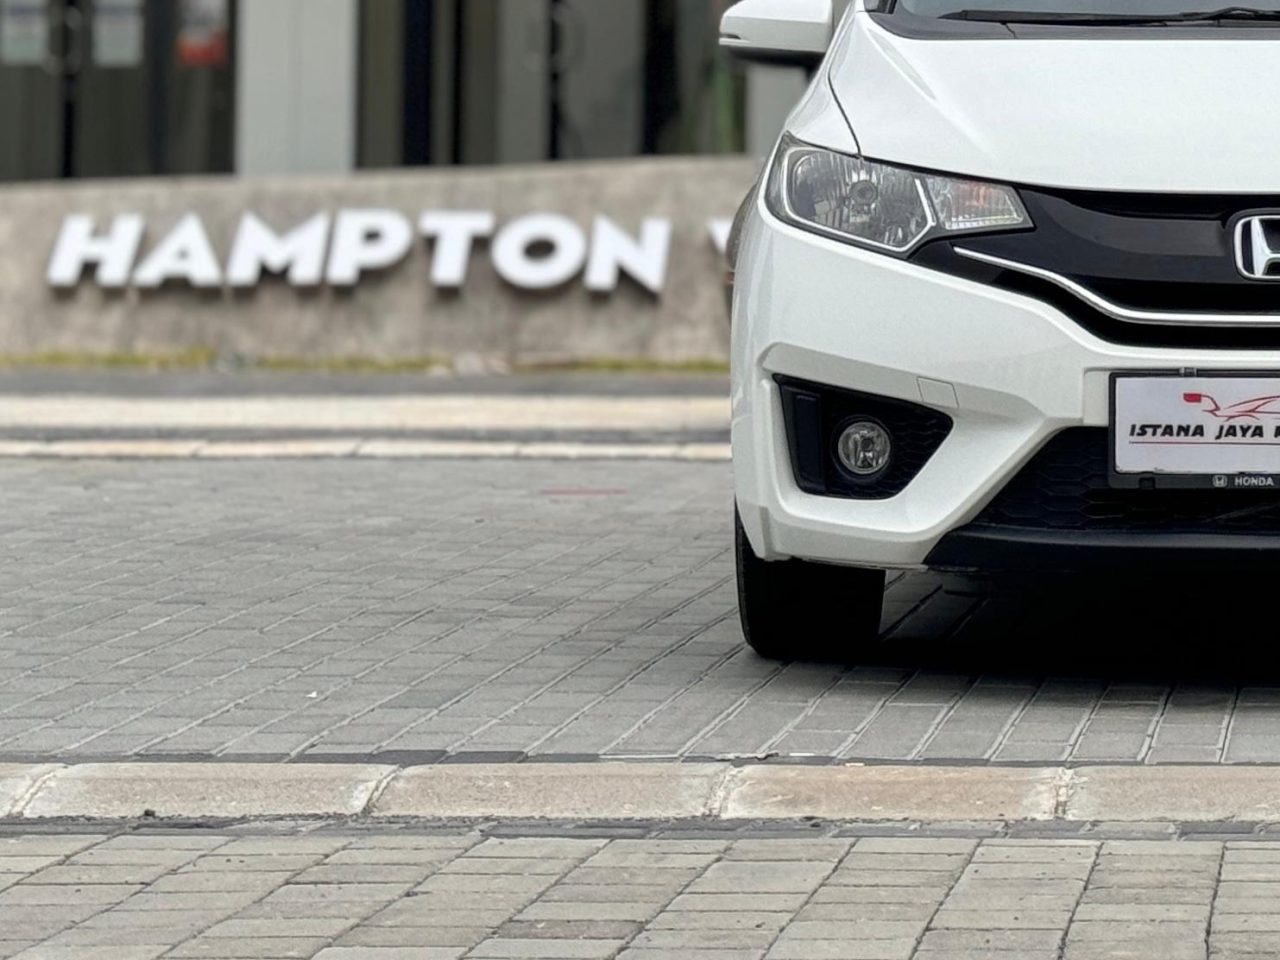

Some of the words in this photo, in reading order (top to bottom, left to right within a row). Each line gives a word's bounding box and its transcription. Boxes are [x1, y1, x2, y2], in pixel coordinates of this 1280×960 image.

[48, 209, 671, 292] HAMPTON
[1129, 423, 1205, 438] ISTANA
[1214, 424, 1264, 440] JAYA
[1234, 475, 1274, 487] HONDA
